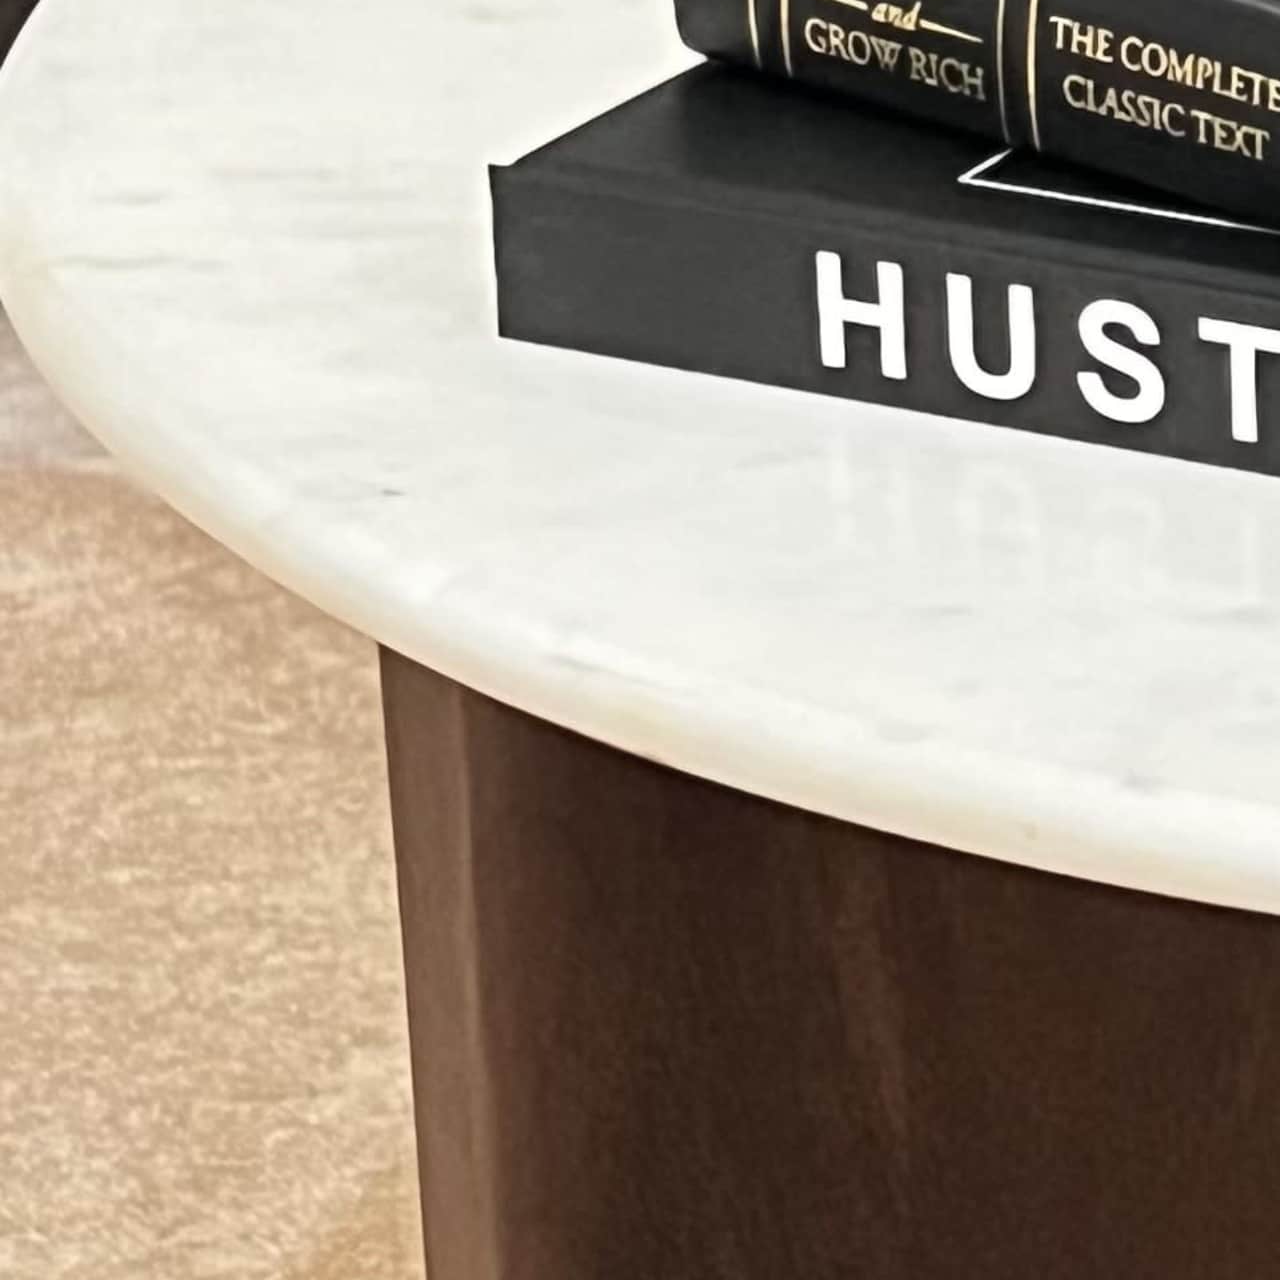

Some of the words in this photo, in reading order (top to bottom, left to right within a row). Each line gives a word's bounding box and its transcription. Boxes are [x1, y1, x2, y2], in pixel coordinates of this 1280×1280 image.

[871, 0, 922, 31] and
[1049, 16, 1115, 63] THE
[804, 18, 904, 73] GROW
[909, 46, 986, 101] RICH
[1062, 74, 1186, 137] CLASSIC
[1190, 109, 1271, 161] TEXT
